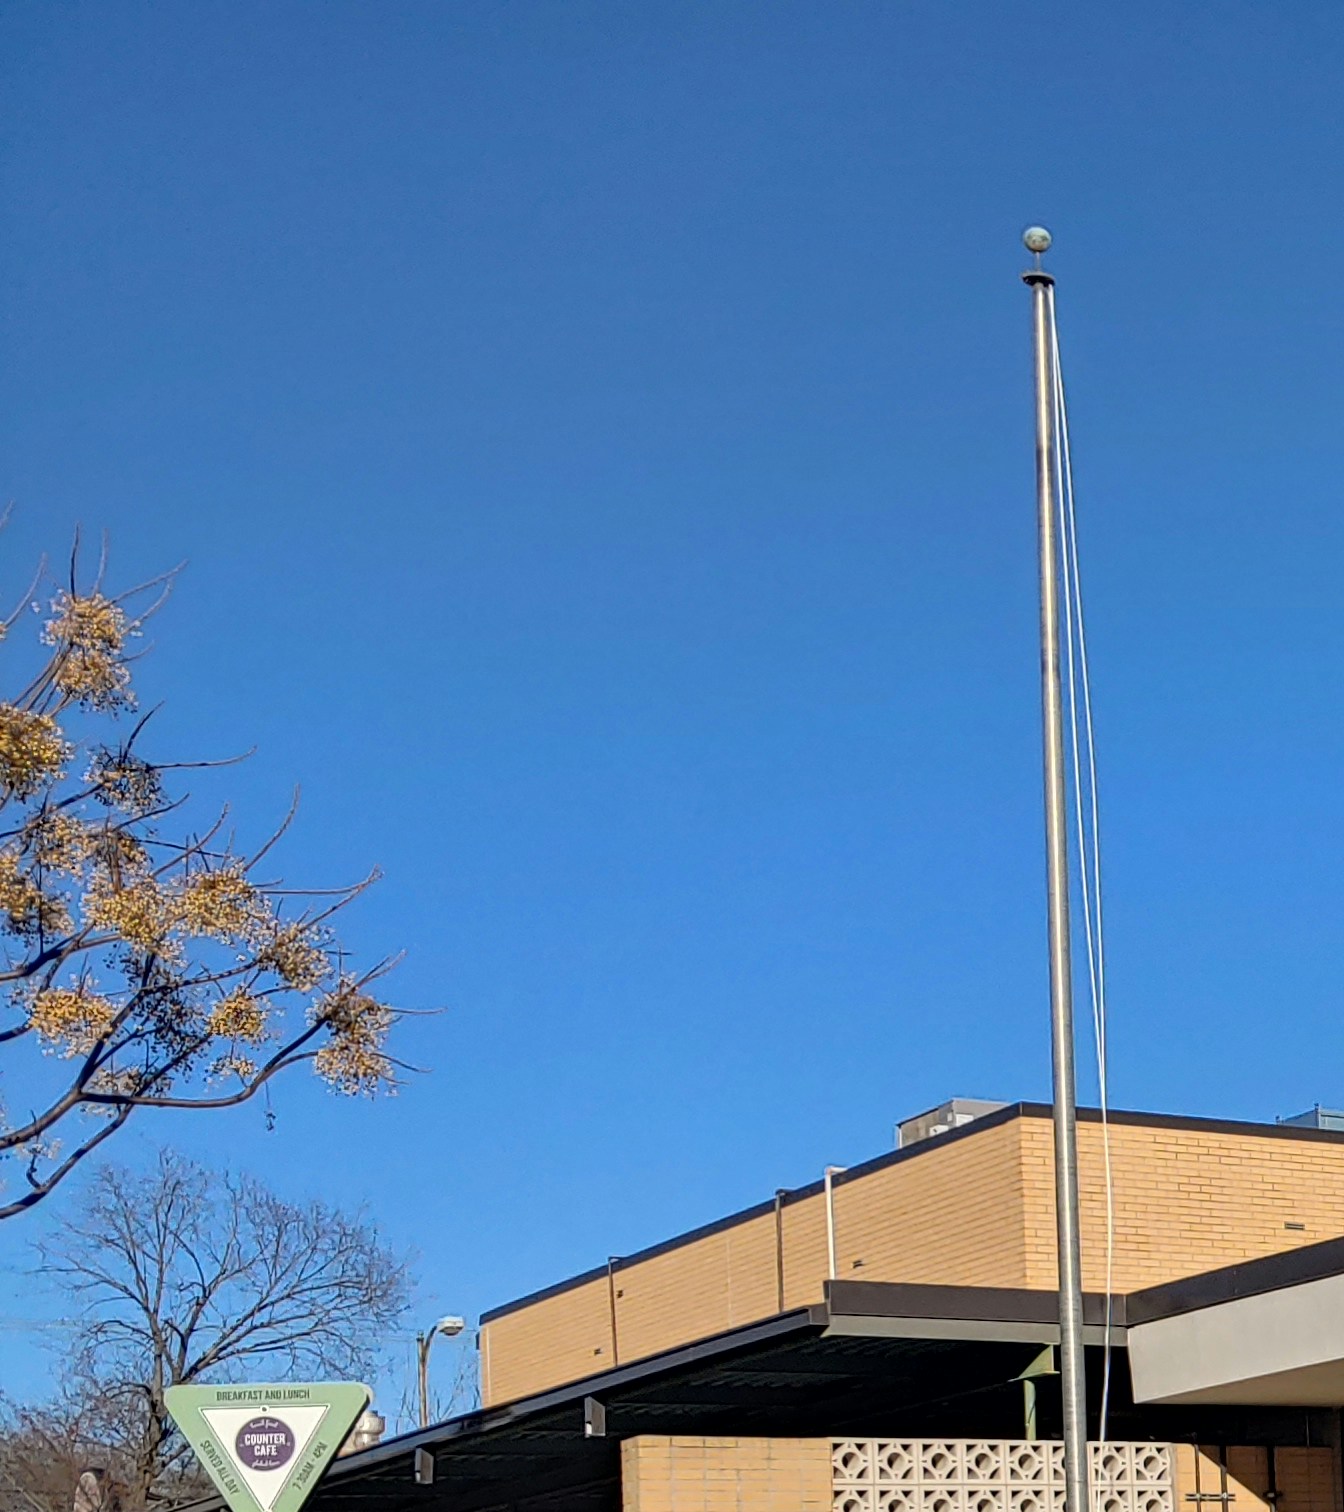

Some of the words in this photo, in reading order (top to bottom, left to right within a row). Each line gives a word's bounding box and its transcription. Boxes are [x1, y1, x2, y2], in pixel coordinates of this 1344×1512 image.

[216, 1389, 263, 1401] BREAKFAST
[264, 1389, 282, 1400] AND
[283, 1388, 310, 1399] LUNCH
[244, 1432, 286, 1446] COUNTER
[253, 1444, 278, 1457] CAFE
